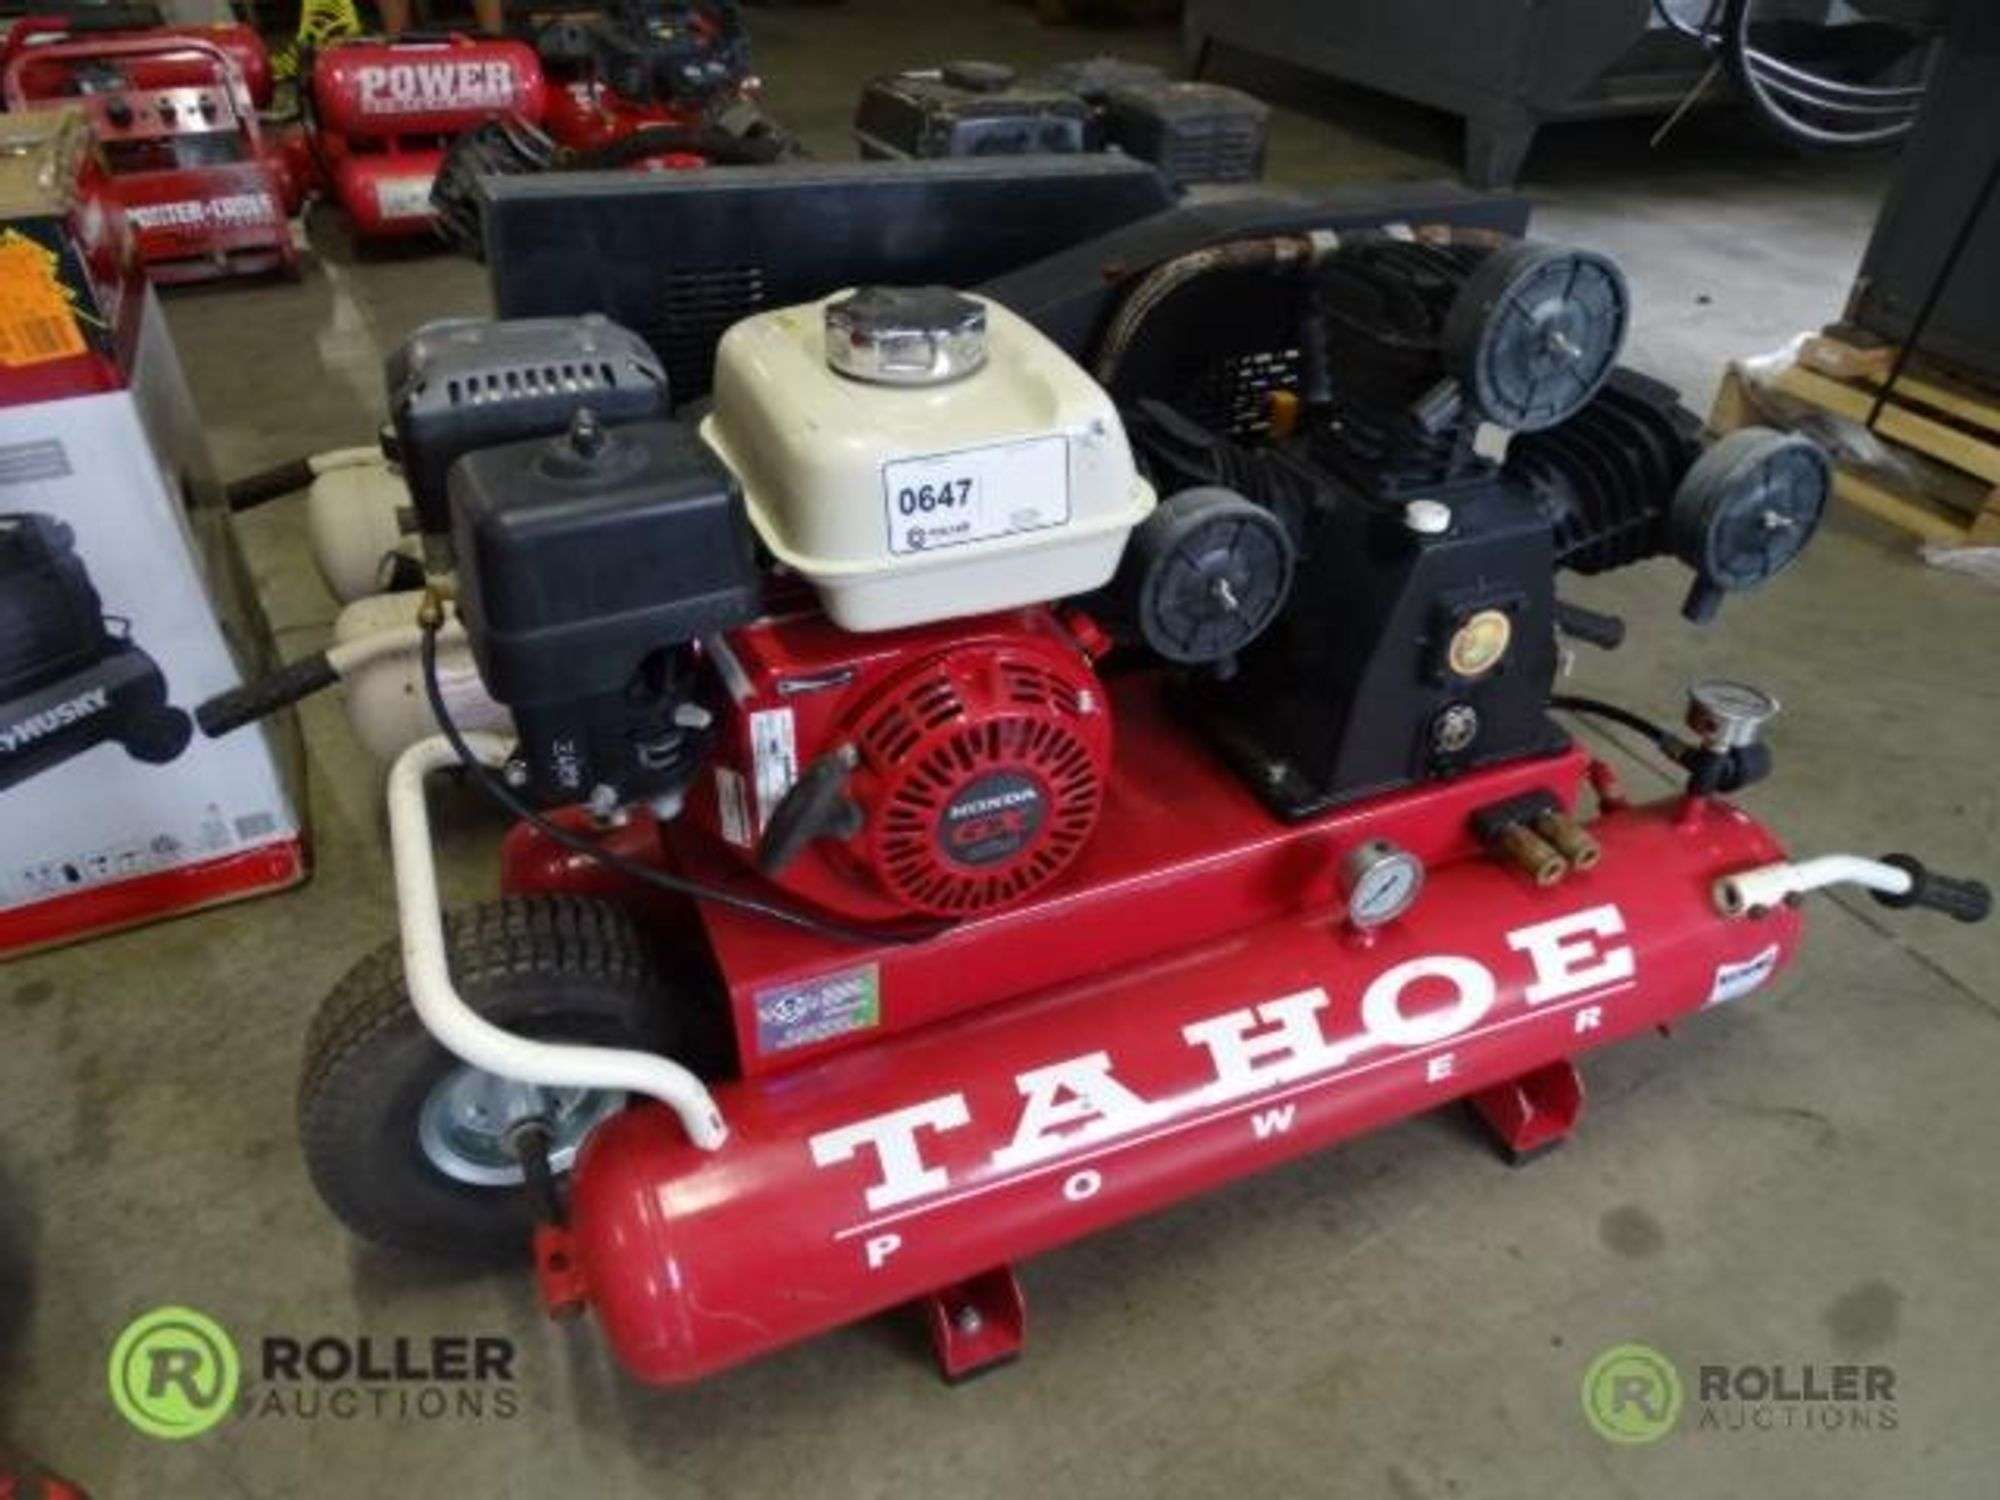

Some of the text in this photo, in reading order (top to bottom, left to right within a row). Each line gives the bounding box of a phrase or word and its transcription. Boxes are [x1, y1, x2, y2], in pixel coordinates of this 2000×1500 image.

[359, 58, 514, 103] POWER
[899, 478, 973, 516] 0647
[12, 686, 108, 742] HUSKY
[949, 788, 1038, 820] HONDA
[810, 902, 1637, 1212] TAHOE
